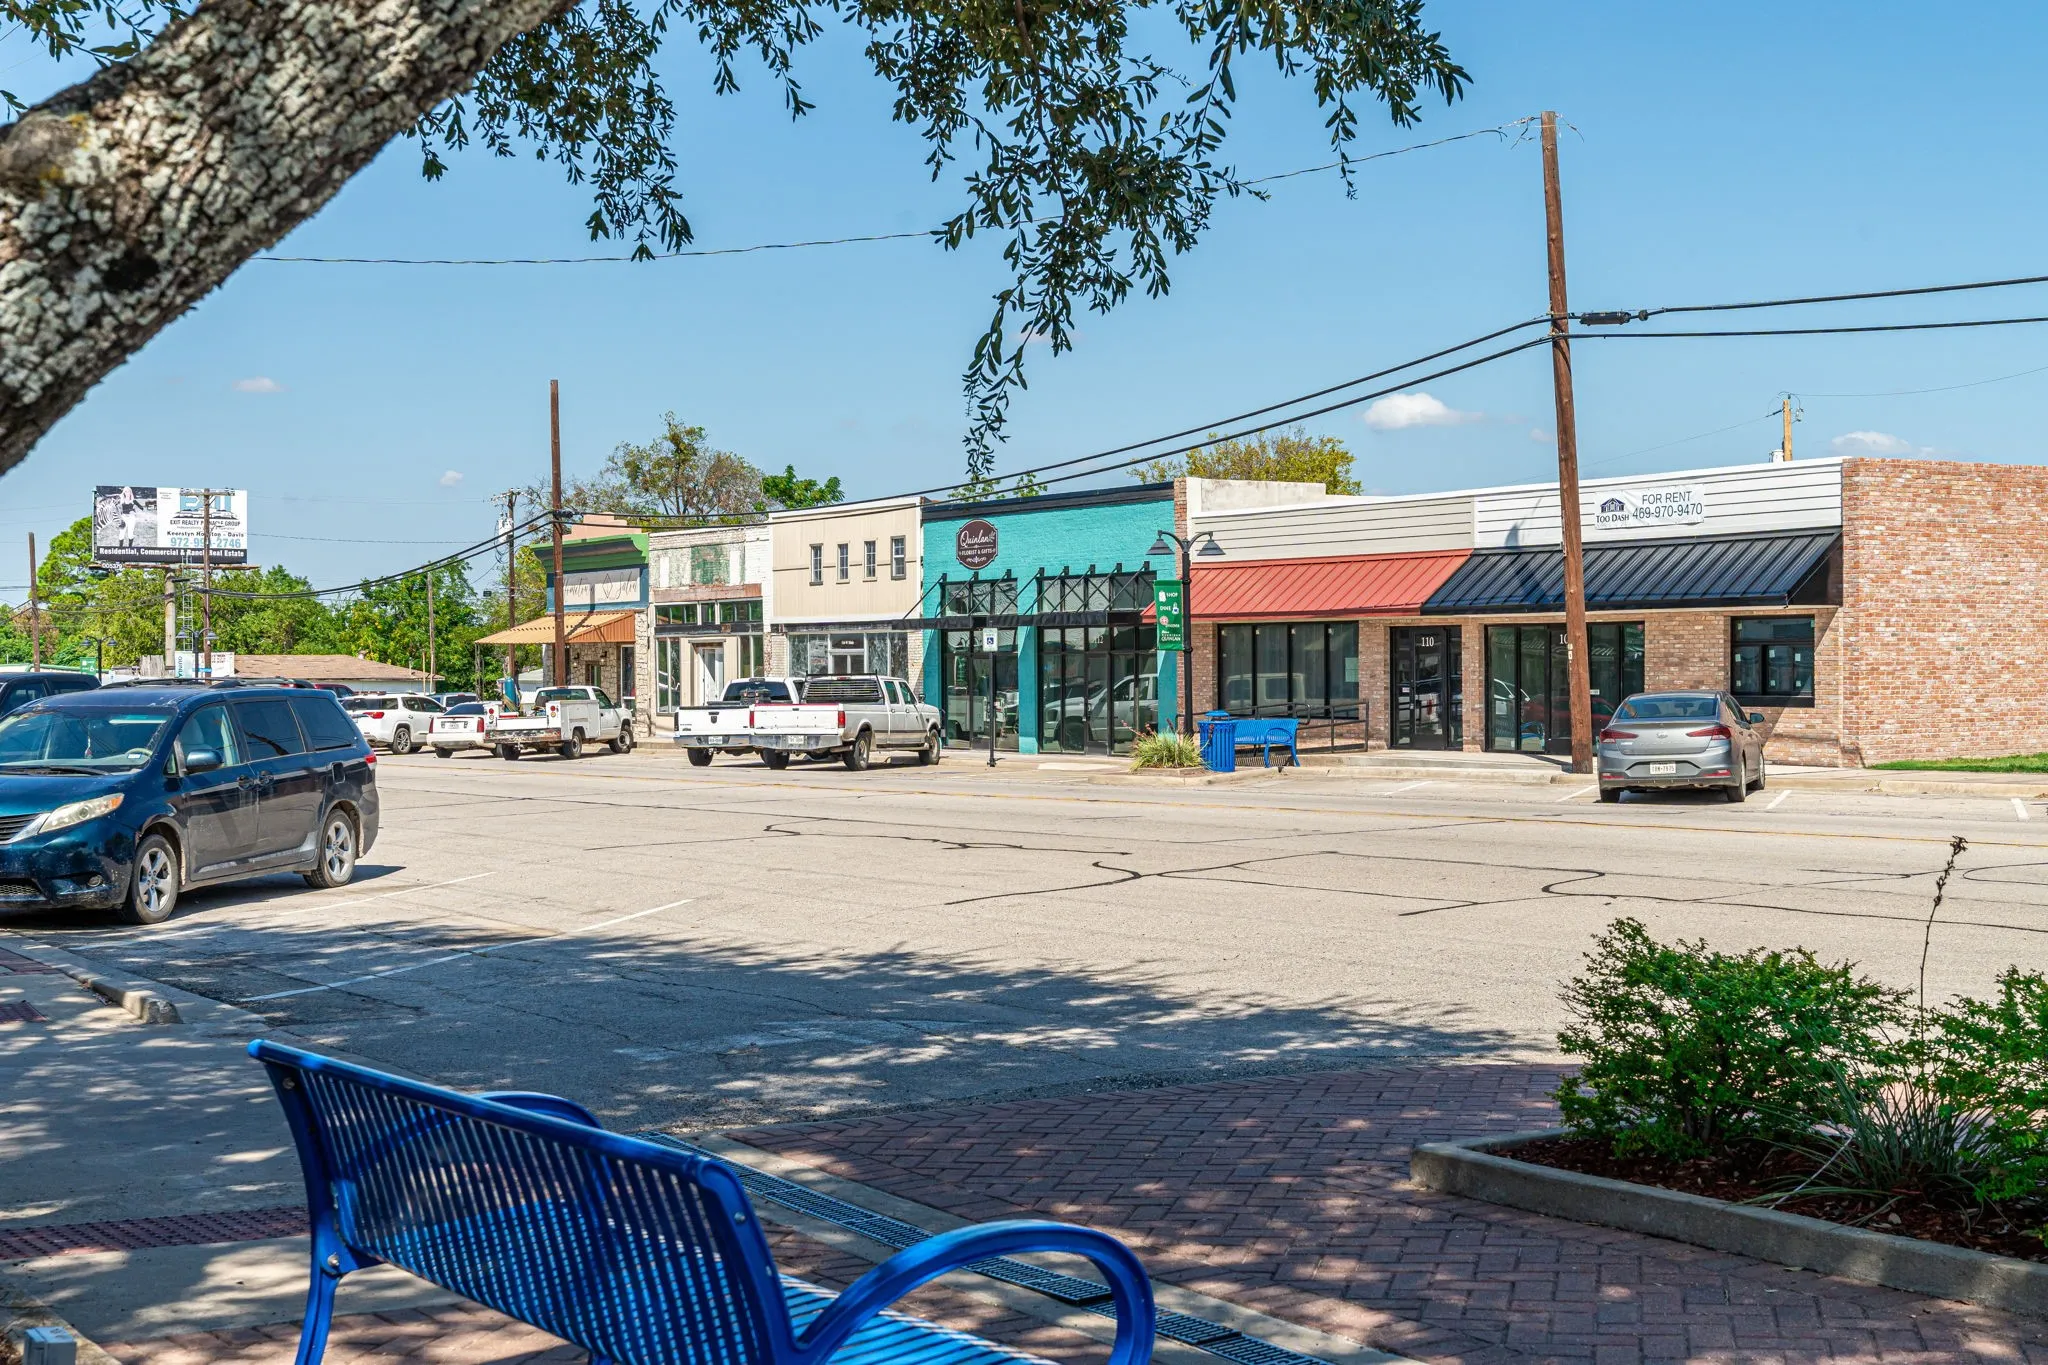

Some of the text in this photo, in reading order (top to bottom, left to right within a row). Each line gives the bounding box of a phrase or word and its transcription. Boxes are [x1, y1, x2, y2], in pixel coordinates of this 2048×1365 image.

[1642, 491, 1692, 505] FOR RENT
[1633, 503, 1703, 519] 469-970-9470
[1596, 514, 1629, 523] TOO DASH
[960, 529, 990, 548] Quinlan
[99, 547, 139, 556] Residential,
[140, 548, 178, 556] Commercial
[1421, 636, 1434, 646] 110
